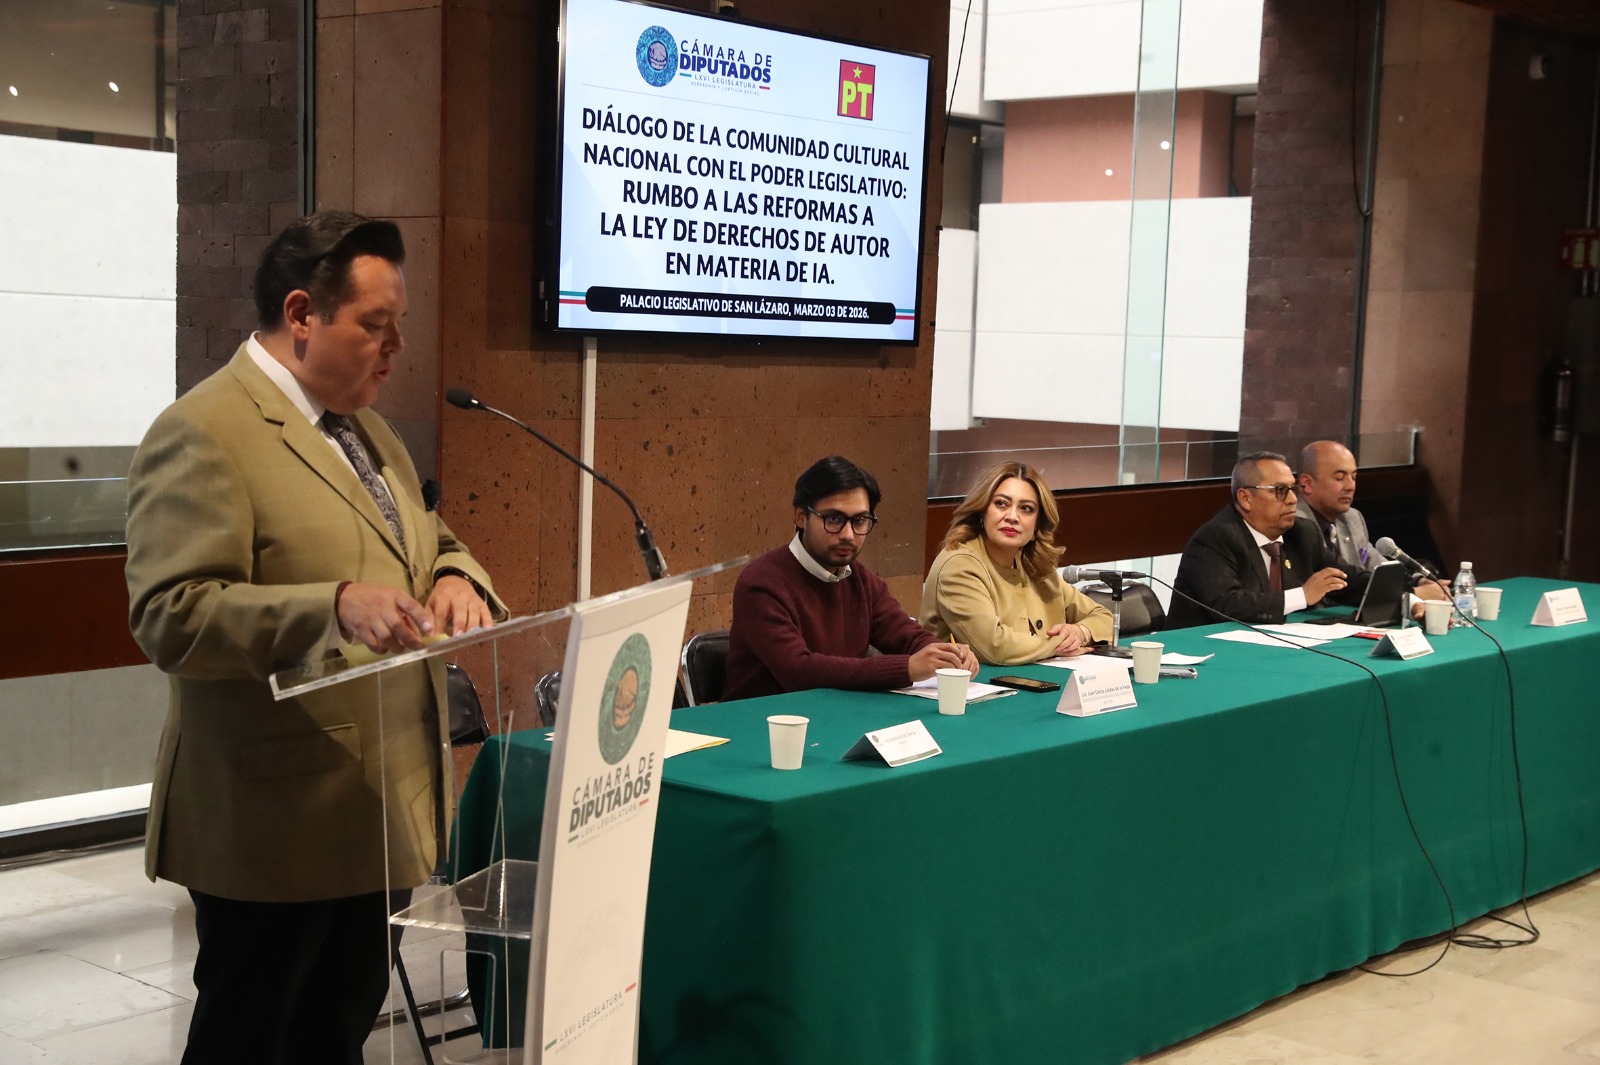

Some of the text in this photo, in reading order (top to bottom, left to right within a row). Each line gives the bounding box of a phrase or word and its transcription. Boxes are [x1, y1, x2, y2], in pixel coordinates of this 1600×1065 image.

[680, 39, 772, 68] CÁMARA DE
[680, 53, 771, 84] DIPUTADOS
[694, 74, 756, 90] LXVI LEGISLATURA
[842, 80, 872, 118] PT
[582, 104, 910, 170] DIÁLOGO DE LA COMUNIDAD CULTURAL
[584, 142, 906, 199] NACIONAL CON EL PODER LEGISLATIVO:
[623, 180, 874, 226] RUMBO A LAS REFORMAS A
[600, 212, 890, 258] LA LEY DE DERECHOS DE AUTOR
[666, 252, 834, 284] EN MATERIA DE IA.
[620, 294, 870, 318] PALACIO LEGISLATIVO DE SAN LÁZARO, MARZO 03 DE 2026.
[573, 752, 654, 805] CÁMARA DE
[570, 772, 652, 833] DIPUTADOS
[560, 991, 622, 1042] LXVI LEGISLATURA
